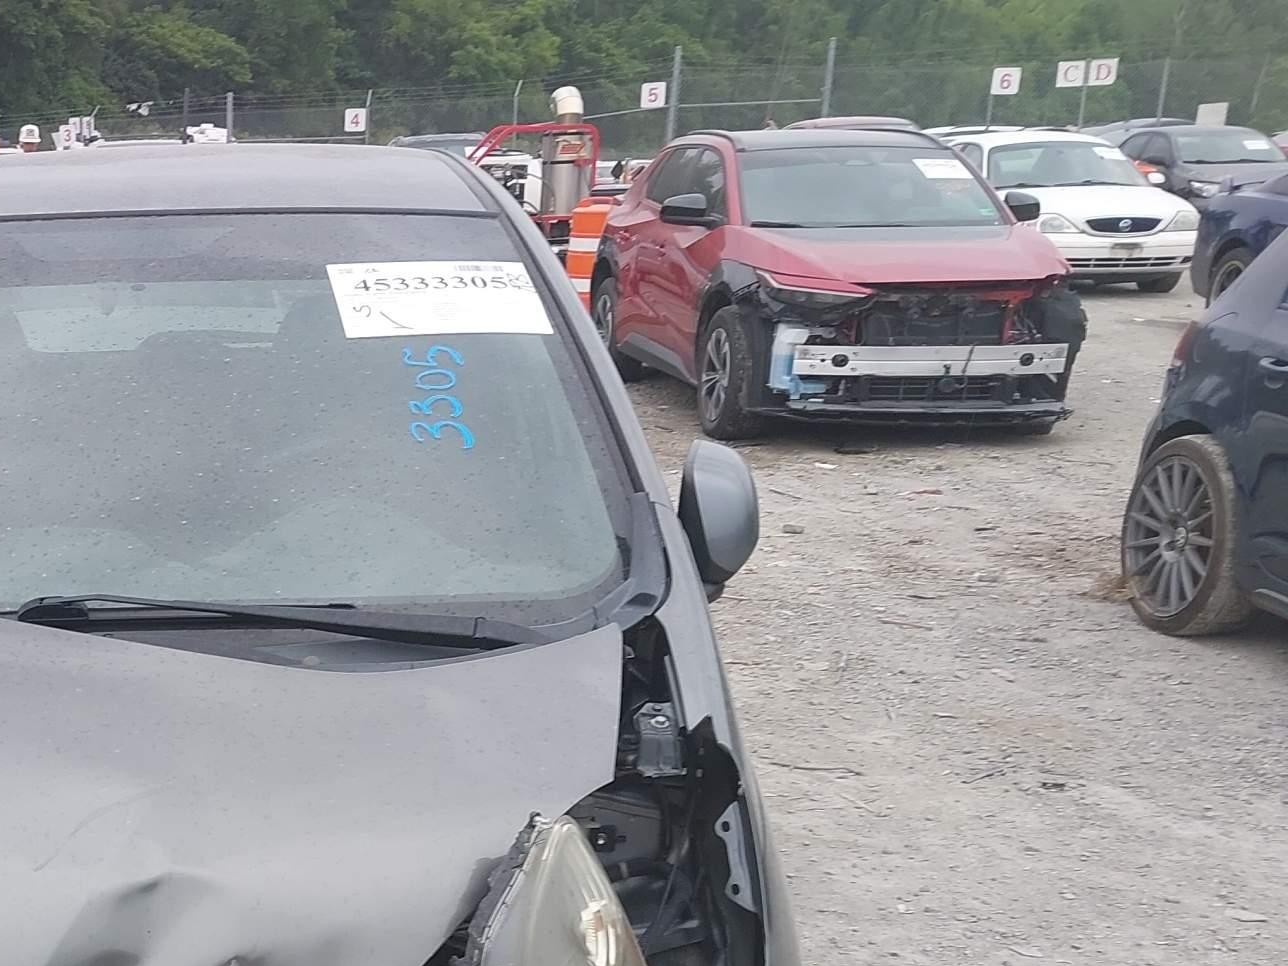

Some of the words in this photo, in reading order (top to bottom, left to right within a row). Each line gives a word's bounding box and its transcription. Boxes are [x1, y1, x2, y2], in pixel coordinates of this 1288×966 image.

[1063, 65, 1080, 83] C
[1095, 63, 1112, 81] D
[999, 73, 1013, 90] 6
[647, 87, 659, 103] 5
[350, 112, 361, 128] 4
[64, 129, 72, 142] 3
[353, 276, 508, 292] 45333305
[401, 345, 475, 449] 3305
